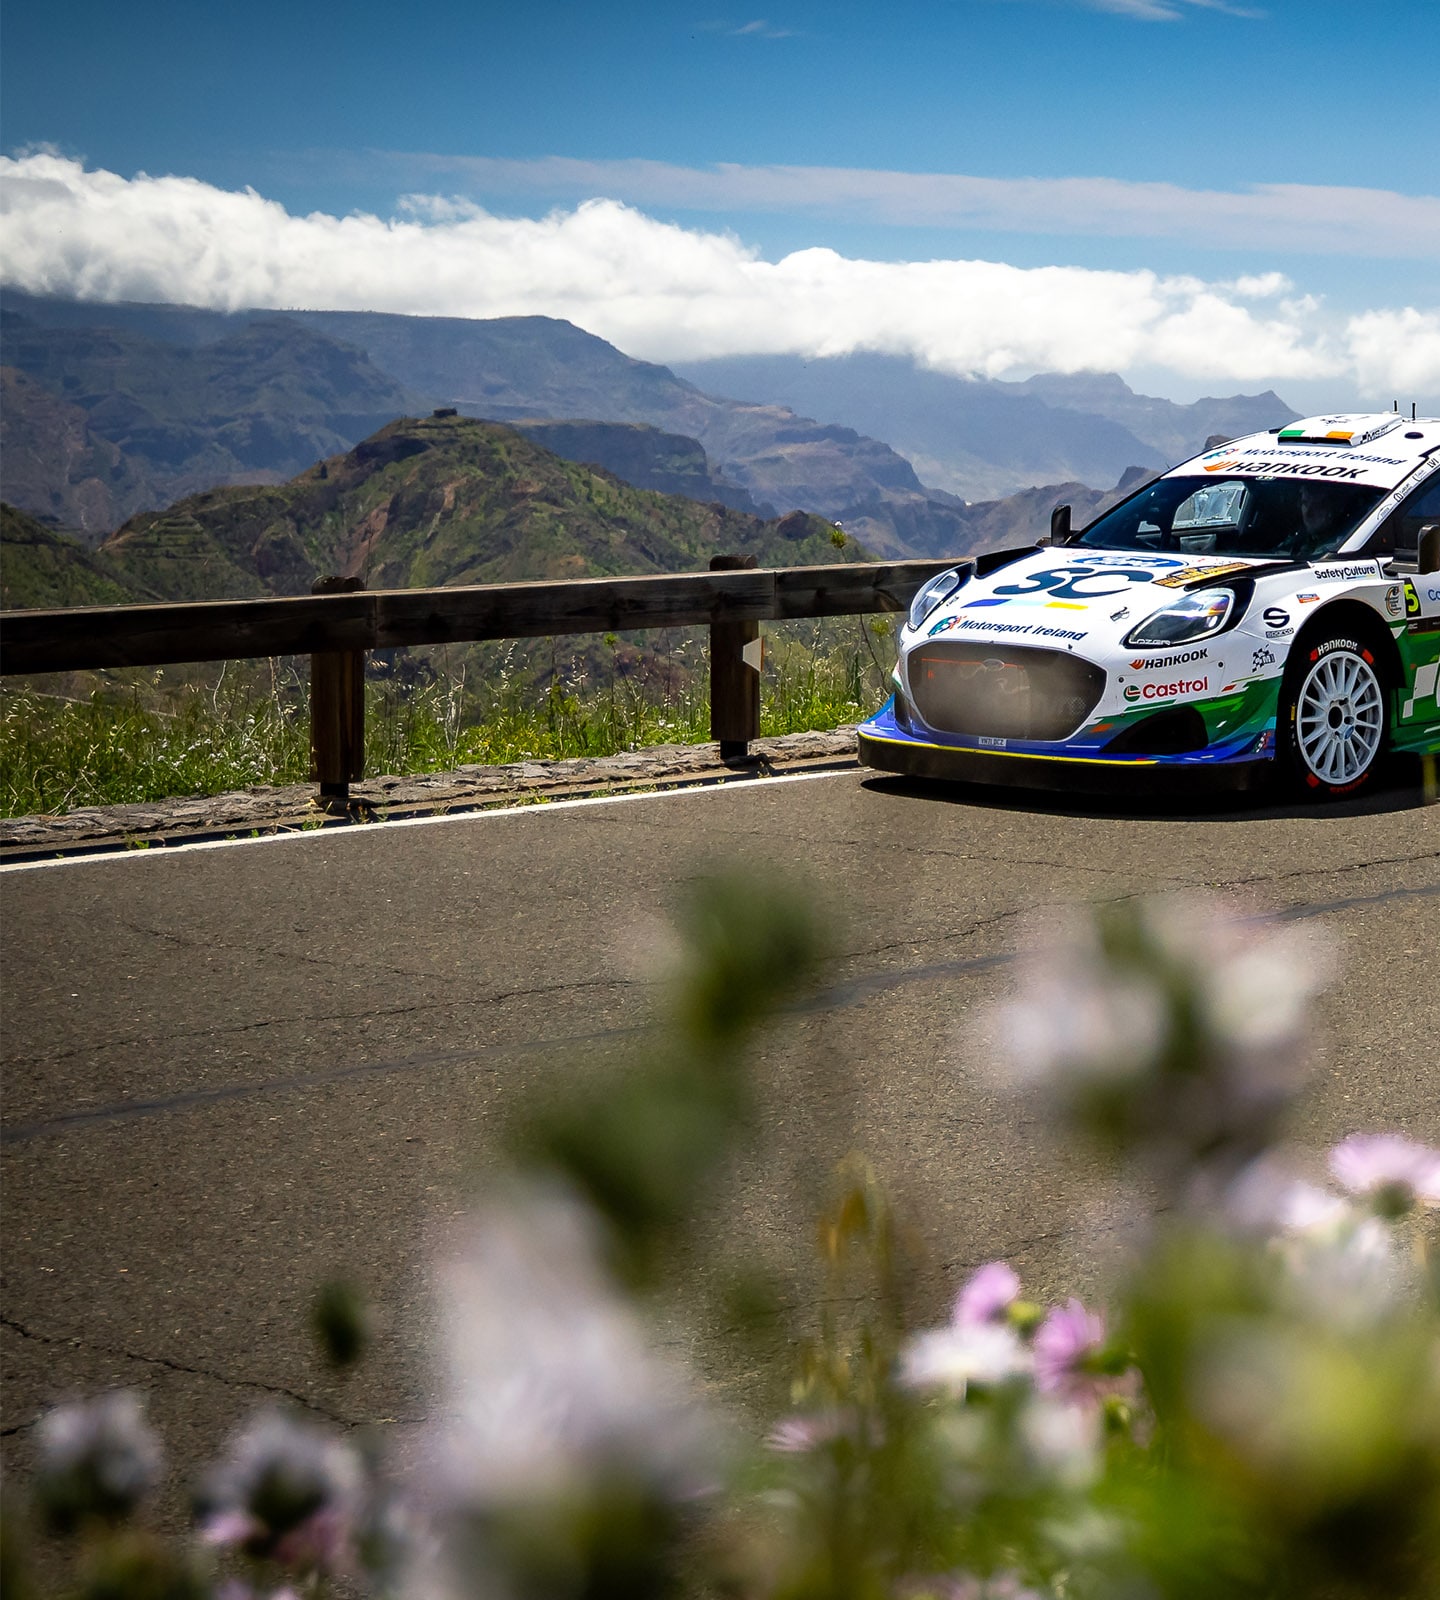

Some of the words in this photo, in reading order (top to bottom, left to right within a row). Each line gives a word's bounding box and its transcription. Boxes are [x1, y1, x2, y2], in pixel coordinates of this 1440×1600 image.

[1241, 449, 1336, 459] Motorsport
[1337, 451, 1408, 465] Ireland
[1314, 565, 1376, 579] SafetyCulture
[957, 620, 1030, 634] Motorsport
[1031, 625, 1089, 641] Ireland
[1142, 676, 1209, 699] Castrol
